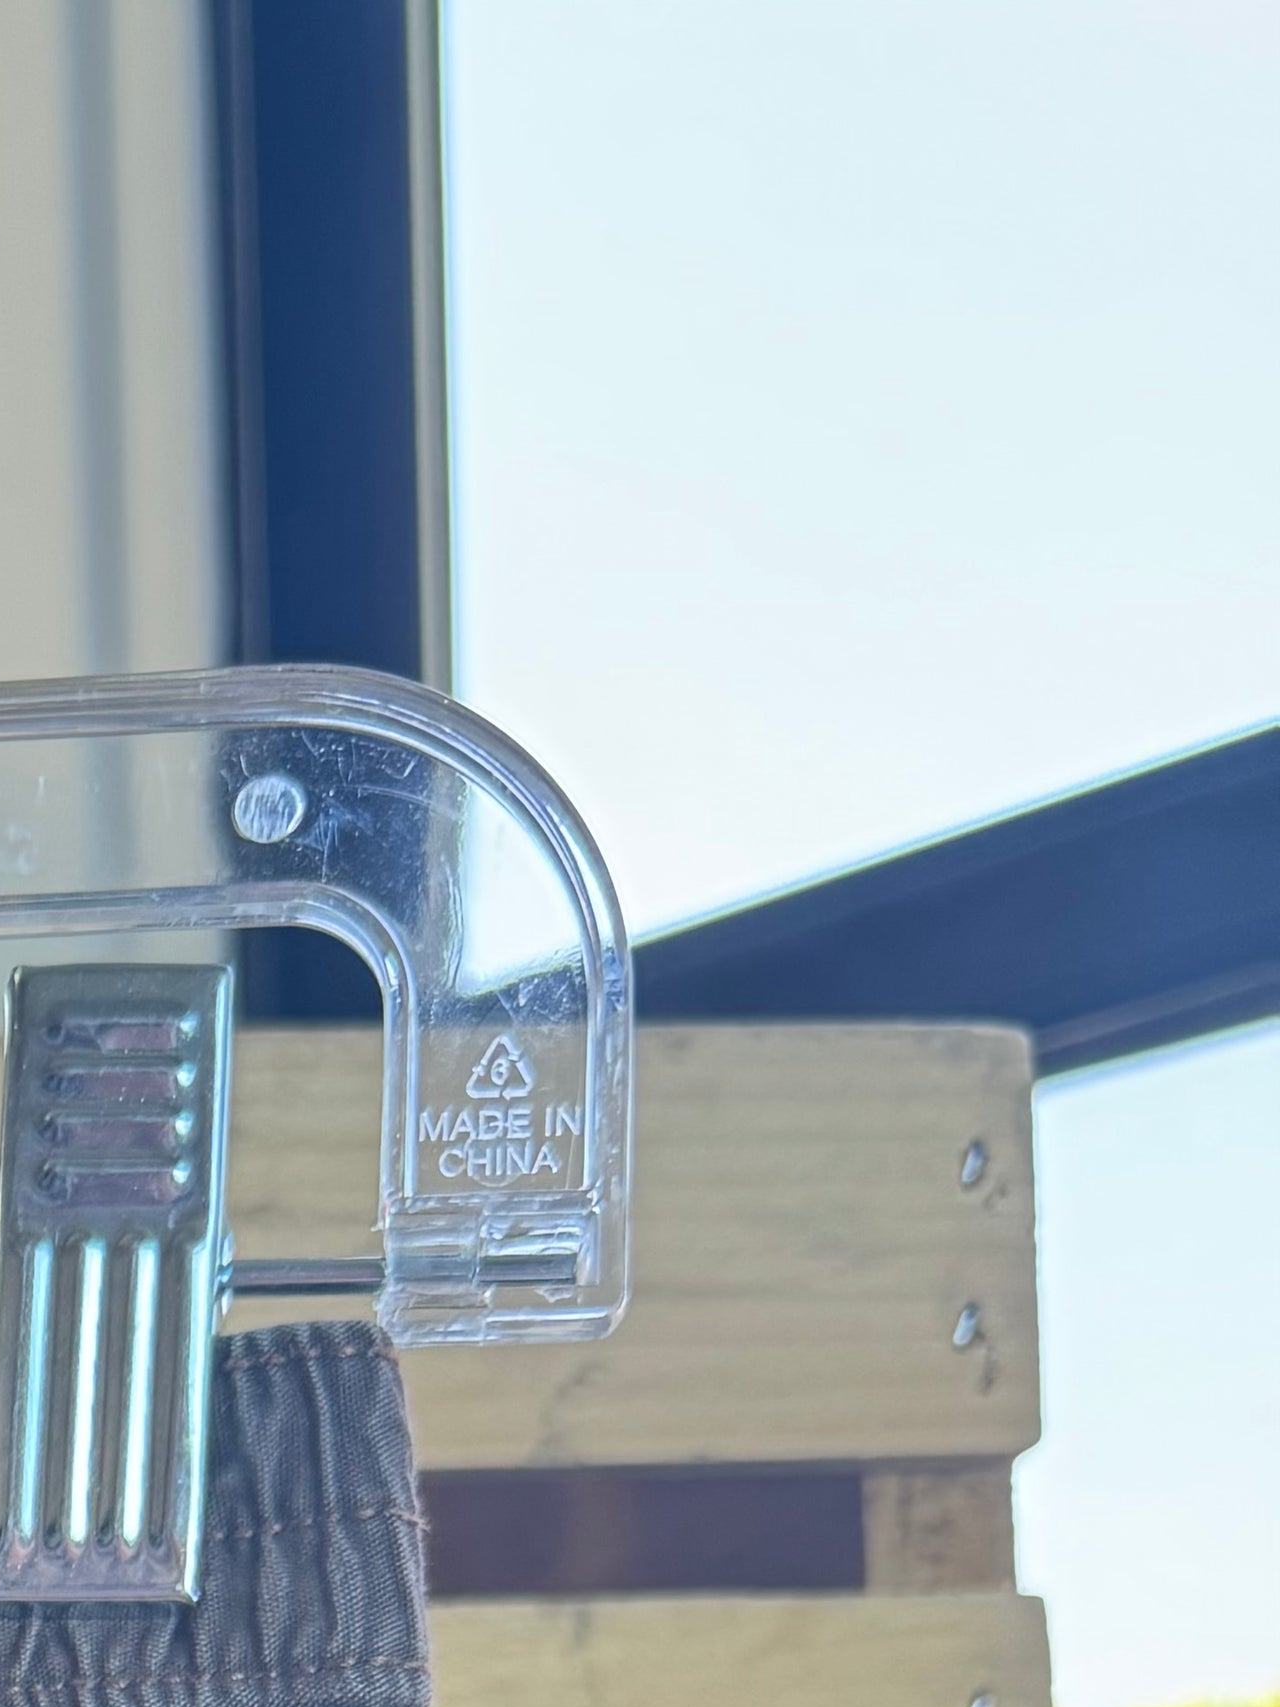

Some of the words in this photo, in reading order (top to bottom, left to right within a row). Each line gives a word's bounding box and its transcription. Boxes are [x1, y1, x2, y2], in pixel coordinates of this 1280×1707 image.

[418, 1106, 533, 1142] MADE
[544, 1105, 582, 1138] IN
[439, 1143, 560, 1179] CHINA
